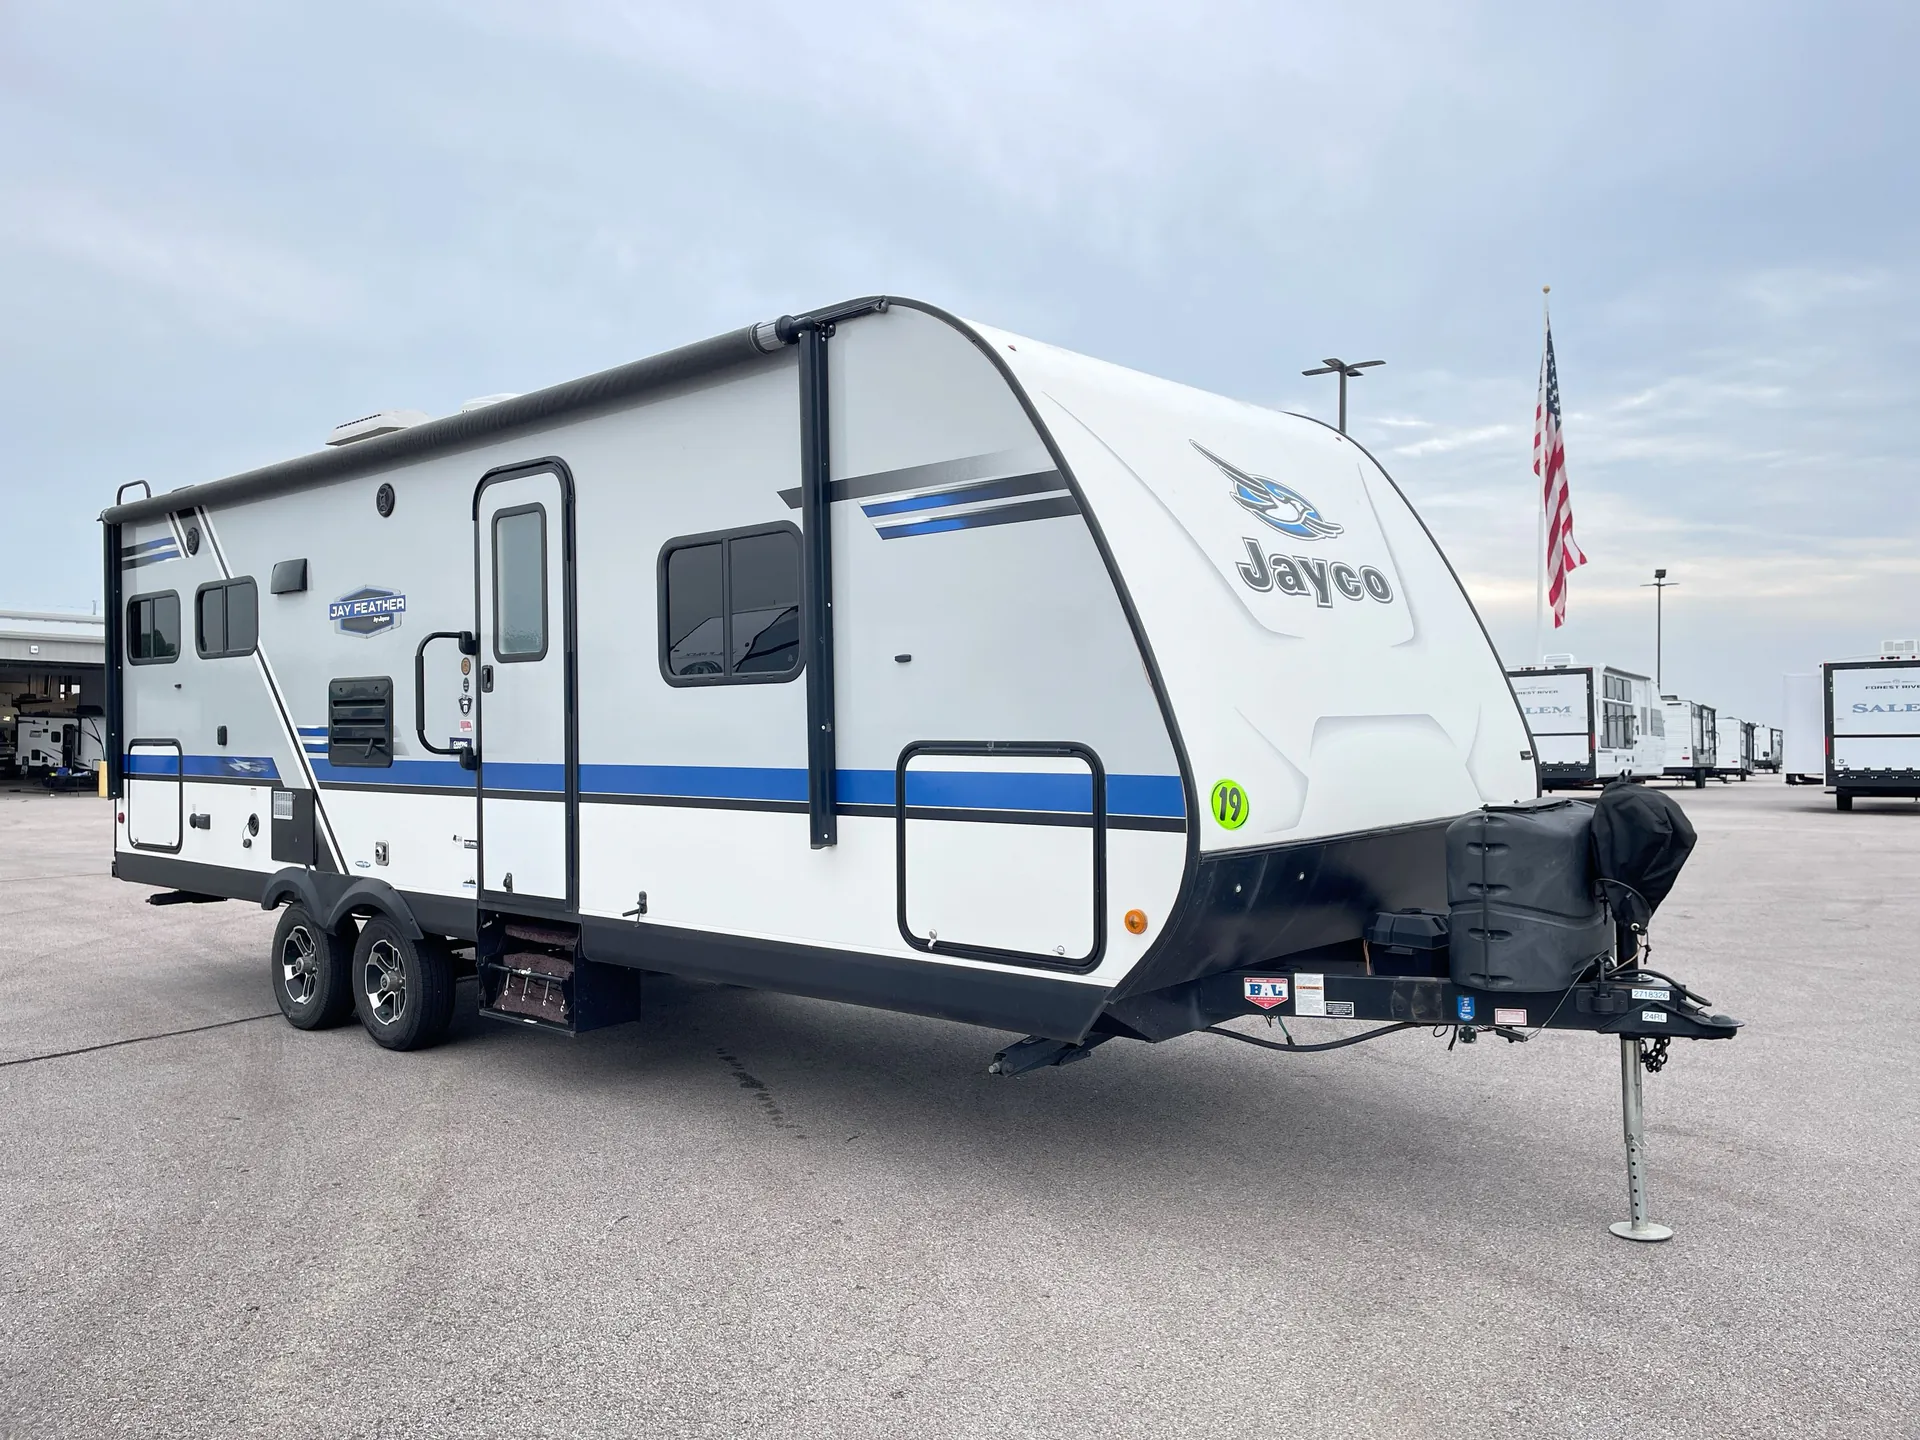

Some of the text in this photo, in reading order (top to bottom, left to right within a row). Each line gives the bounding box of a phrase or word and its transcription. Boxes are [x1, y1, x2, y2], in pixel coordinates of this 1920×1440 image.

[1235, 537, 1394, 608] Jayco
[330, 598, 404, 617] JAY FEATHER
[1525, 706, 1572, 714] LEM
[1852, 703, 1920, 713] SALE
[1219, 786, 1241, 822] 19
[1634, 991, 1668, 999] 2718326
[1644, 1013, 1665, 1021] 24RL
